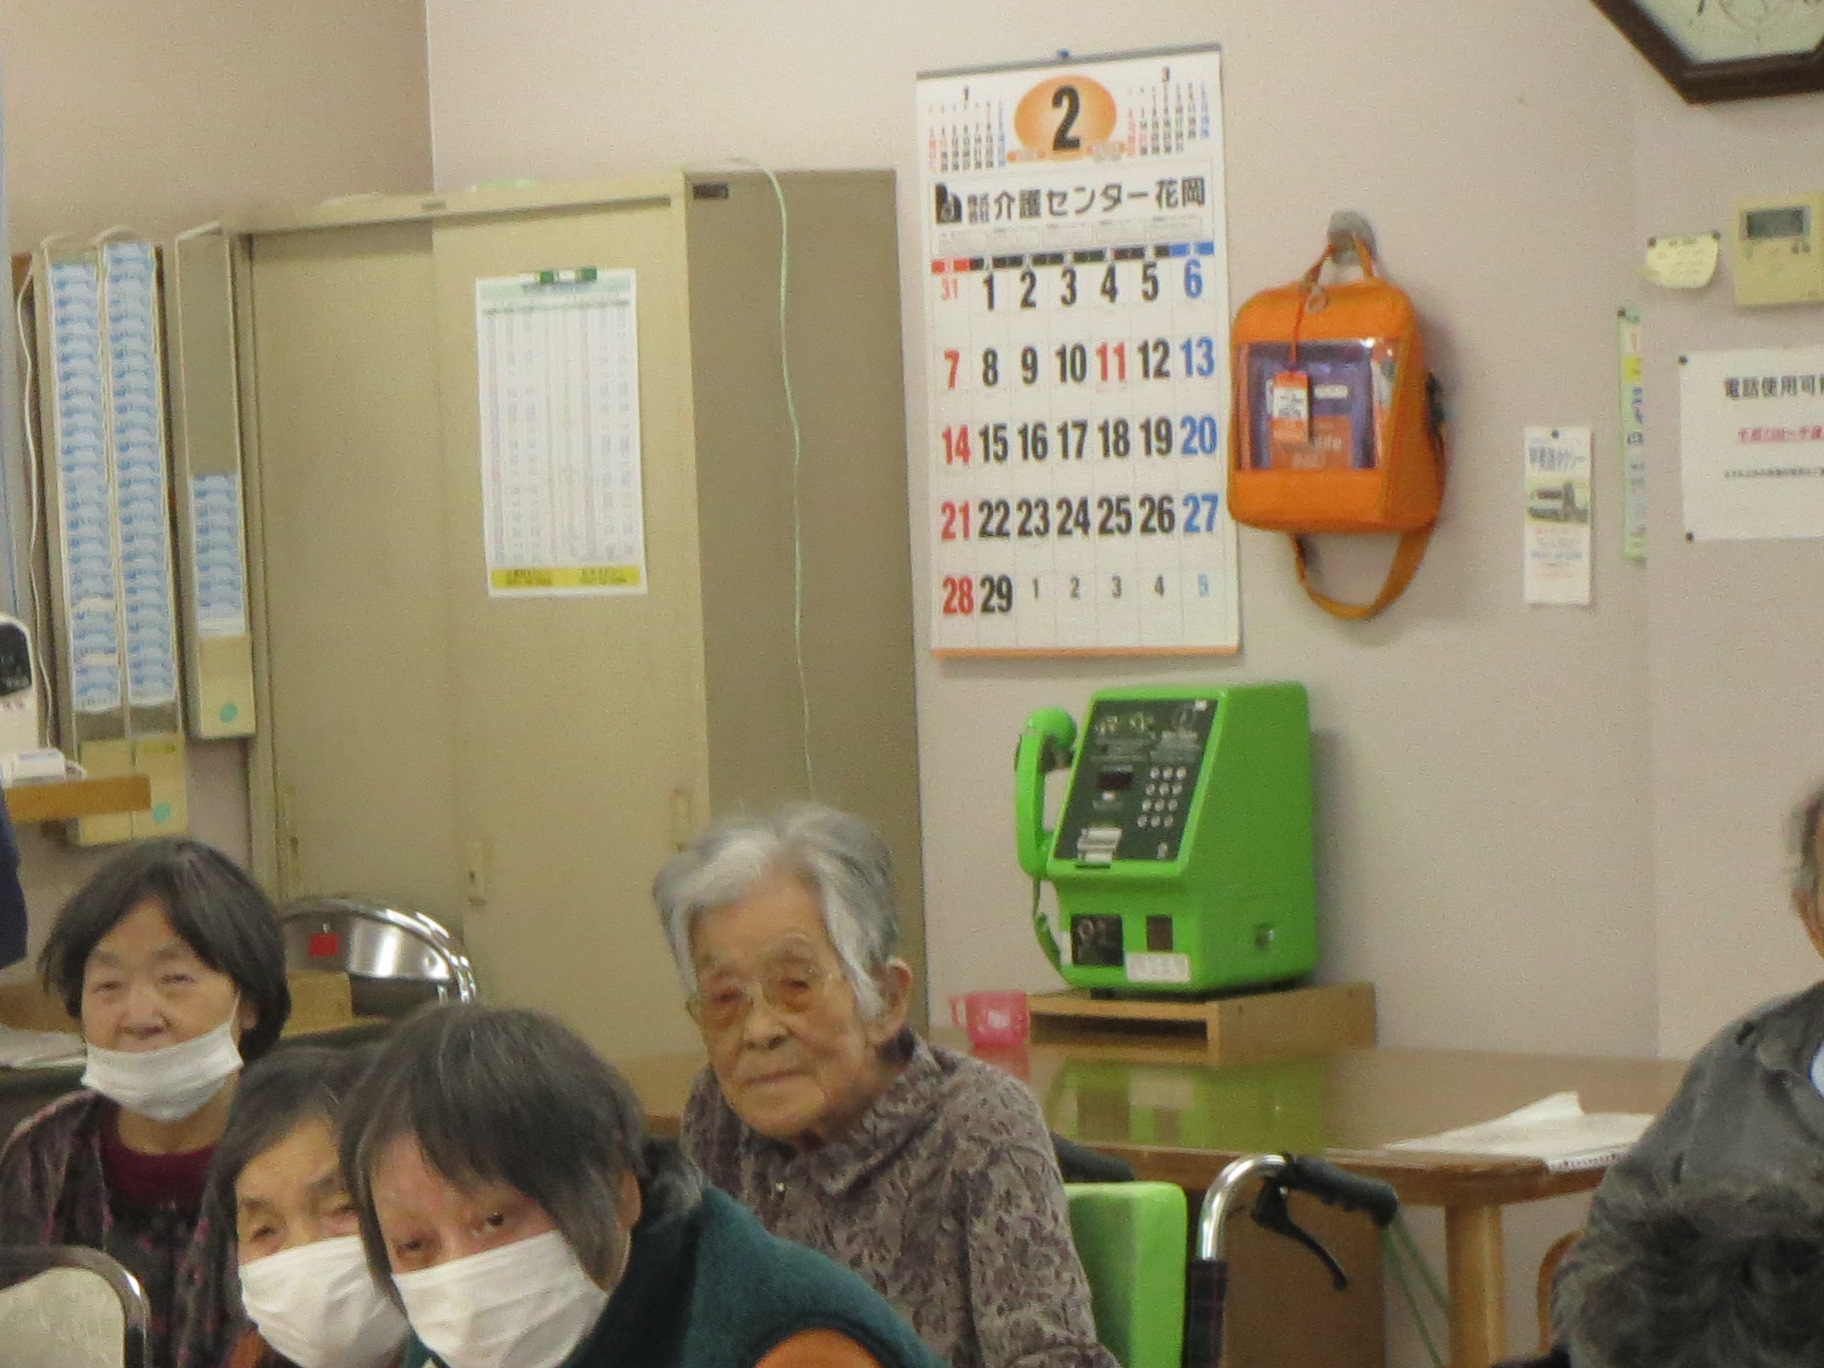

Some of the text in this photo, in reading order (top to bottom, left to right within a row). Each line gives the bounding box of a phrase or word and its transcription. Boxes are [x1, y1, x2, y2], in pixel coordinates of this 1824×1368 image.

[1052, 86, 1081, 151] 2
[983, 274, 994, 311] 1
[1020, 271, 1036, 308] 2
[1061, 267, 1076, 306] 3
[1101, 264, 1117, 303] 4
[1142, 262, 1158, 301] 5
[1184, 259, 1202, 298] 6
[944, 336, 1215, 390] 7 8 9 10 11 12 13
[942, 415, 1217, 464] 14 15 16 17 18 19 20
[941, 493, 1218, 540] 21 22 23 24 25 26 27
[942, 576, 974, 614] 28
[980, 575, 1013, 613] 29
